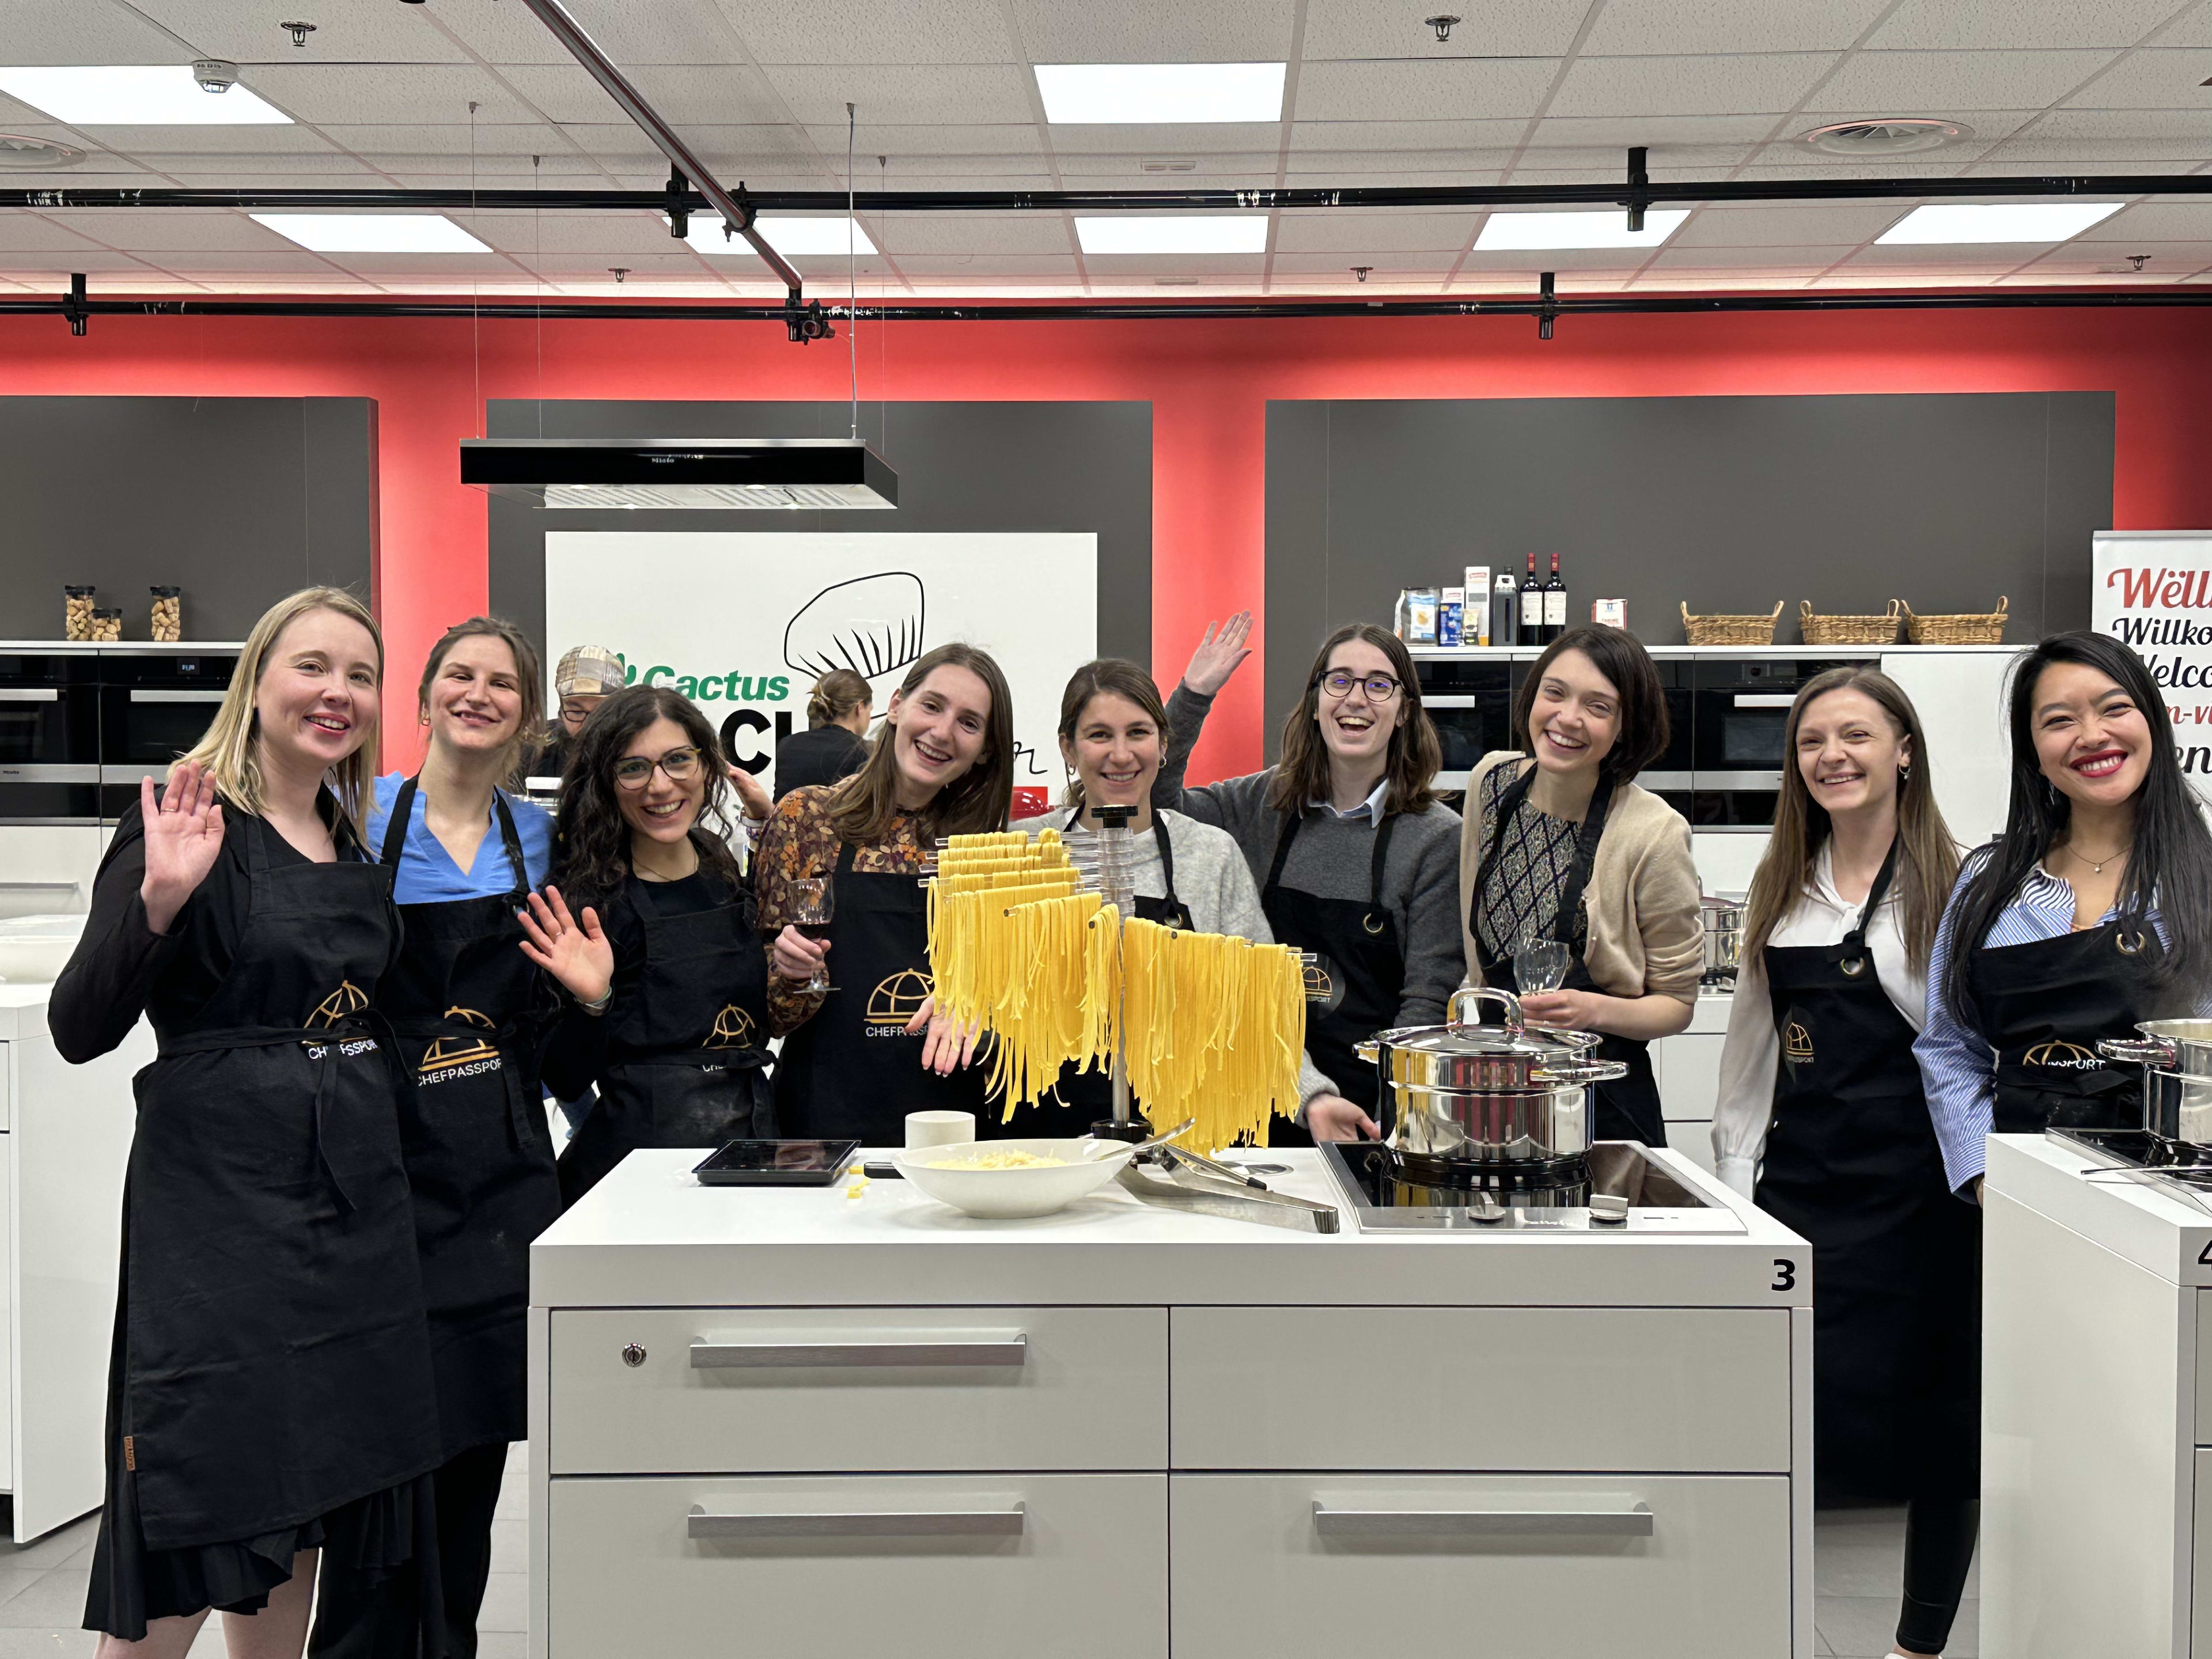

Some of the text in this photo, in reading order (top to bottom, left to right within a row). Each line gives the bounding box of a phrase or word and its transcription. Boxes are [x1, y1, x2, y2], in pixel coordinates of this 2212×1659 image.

[2107, 568, 2212, 608] Wëll
[2112, 618, 2212, 645] Willko
[642, 665, 790, 701] Cactus
[1771, 1259, 1796, 1291] 3
